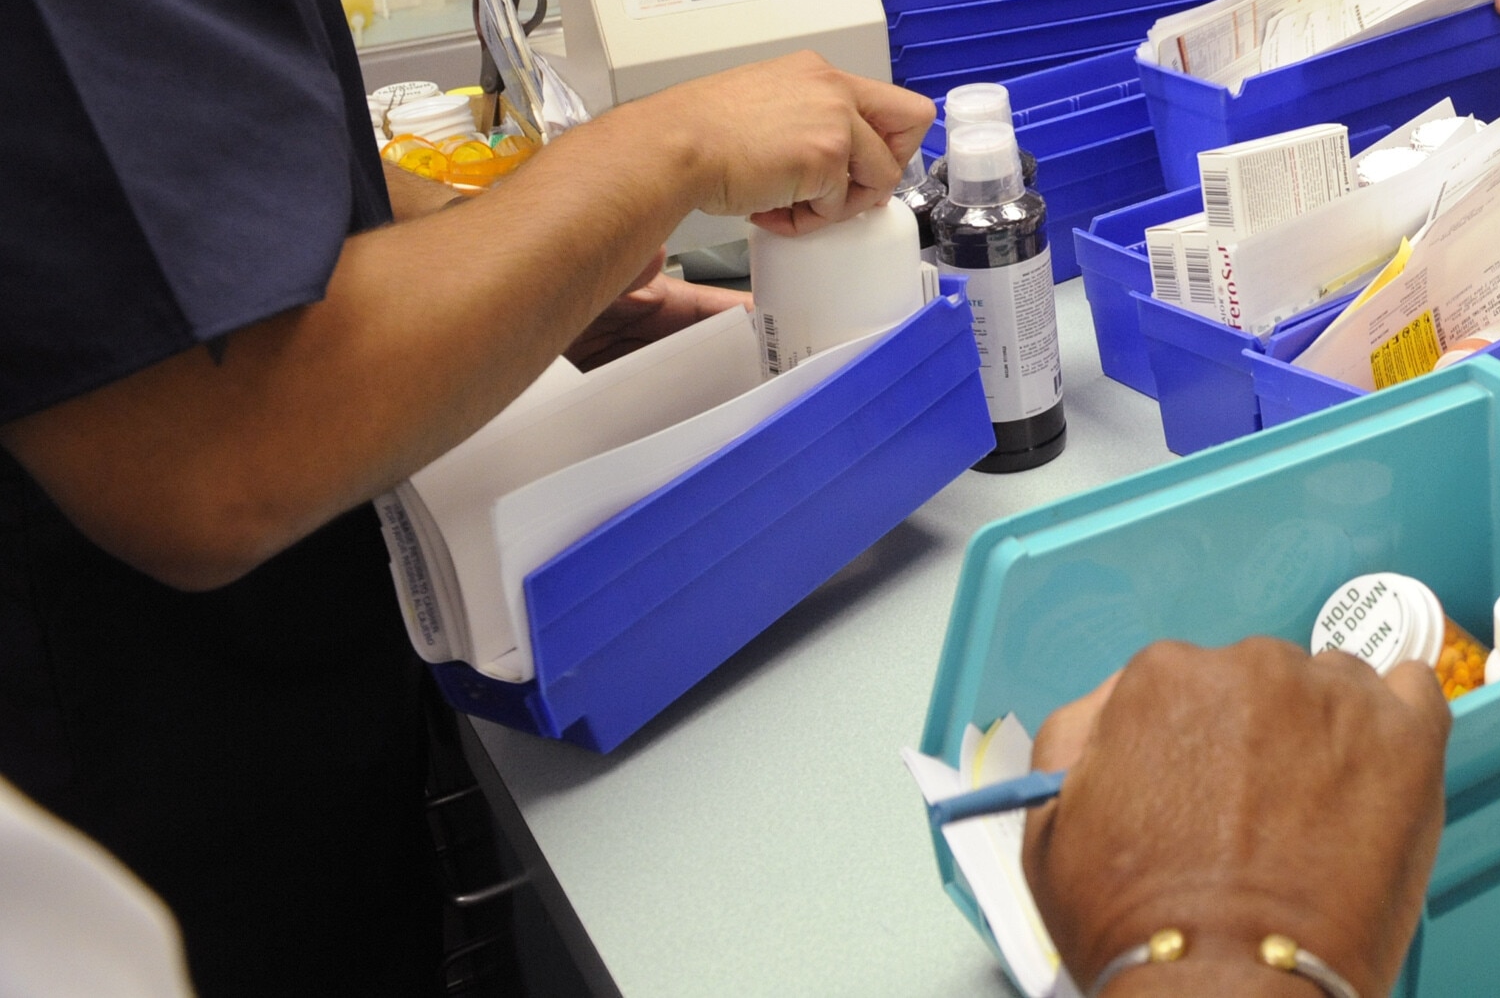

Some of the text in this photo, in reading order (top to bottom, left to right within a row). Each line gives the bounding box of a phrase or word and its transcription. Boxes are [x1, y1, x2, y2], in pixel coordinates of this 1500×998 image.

[1339, 134, 1349, 185] Supplement
[1219, 296, 1227, 326] AJOR
[1320, 580, 1388, 652] AB DOWN
[1321, 587, 1360, 632] HOLD
[1355, 621, 1393, 658] URN
